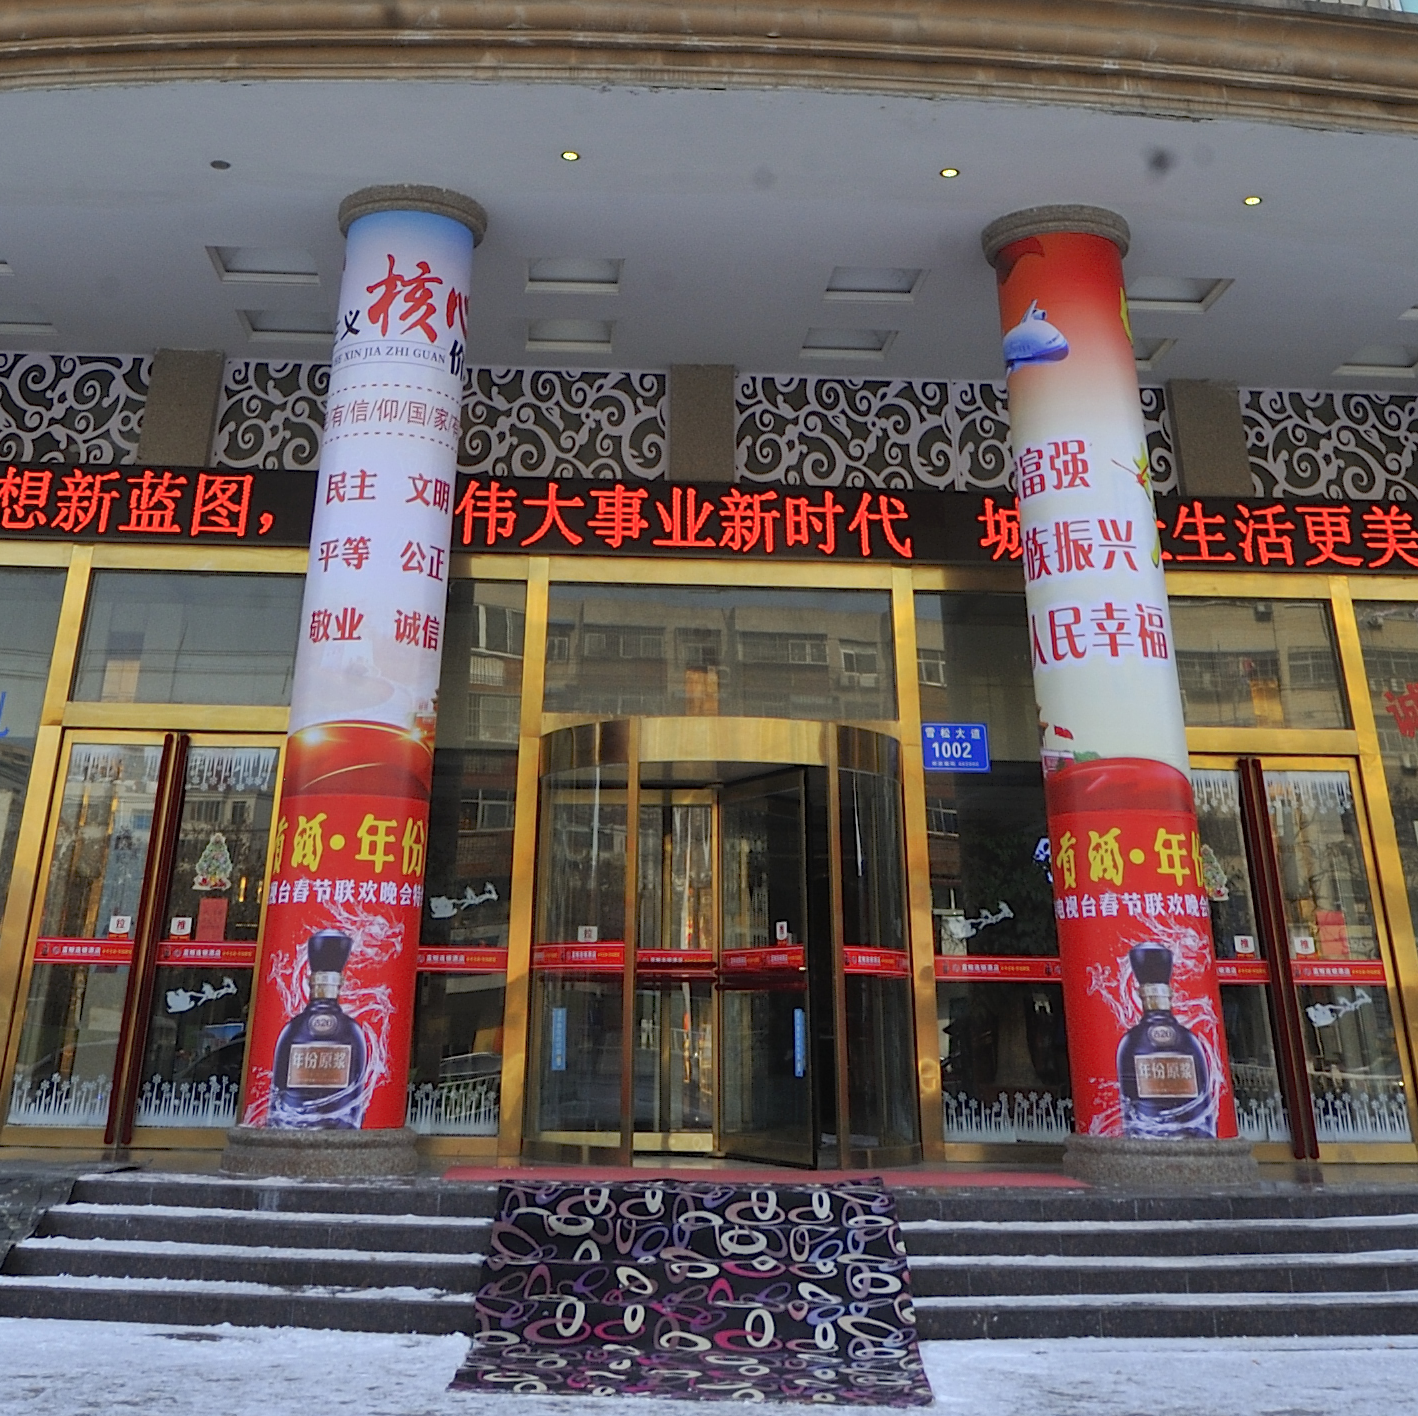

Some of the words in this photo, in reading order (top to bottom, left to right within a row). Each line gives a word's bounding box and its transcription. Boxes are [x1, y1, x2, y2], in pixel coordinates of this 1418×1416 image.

[385, 345, 410, 357] ZHI
[413, 348, 446, 365] GUAN
[325, 470, 379, 506] 民主
[405, 471, 451, 515] 文明
[1015, 439, 1092, 500] 富强
[454, 480, 914, 559] 伟大事业新时代
[317, 536, 372, 573] 平等
[400, 539, 445, 583] 公正
[1022, 519, 1139, 584] 族振兴
[309, 606, 365, 644] 敬业
[394, 608, 441, 653] 诚信
[932, 741, 972, 759] 1002
